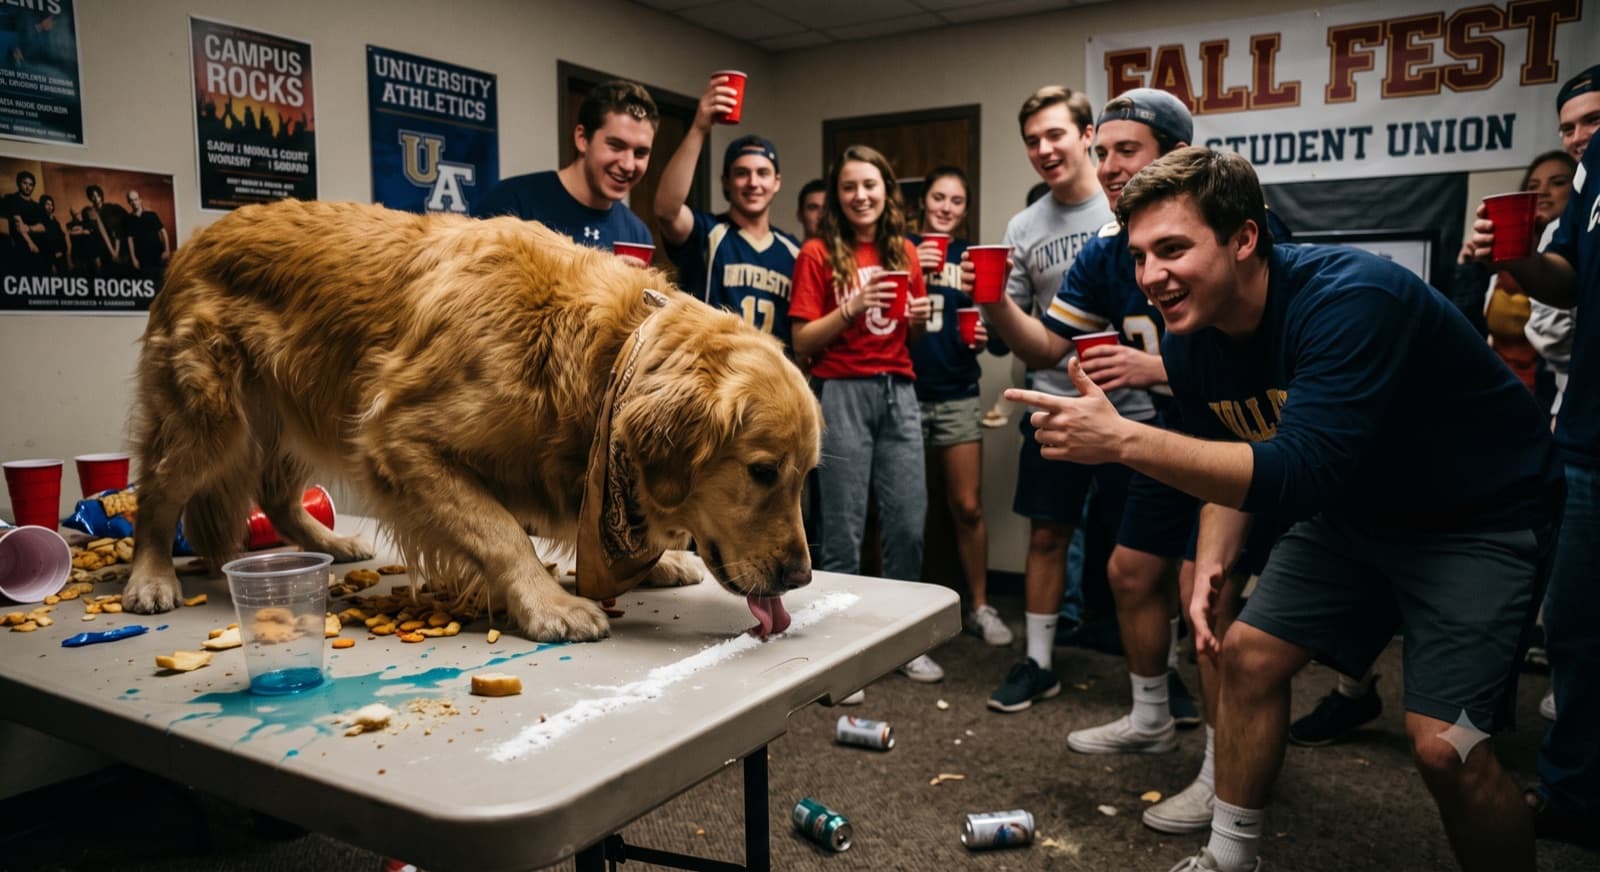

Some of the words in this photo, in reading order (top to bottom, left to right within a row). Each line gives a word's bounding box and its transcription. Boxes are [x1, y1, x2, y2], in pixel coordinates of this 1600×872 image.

[204, 34, 303, 77] CAMPUS
[374, 54, 493, 99] UNIVERSITY
[1103, 32, 1302, 117] FALL
[1324, 0, 1583, 105] FEST
[206, 61, 305, 108] ROCKS
[382, 82, 486, 121] ATHLETICS
[1386, 112, 1517, 157] UNION
[3, 275, 88, 296] CAMPUS
[94, 278, 156, 298] ROCKS
[740, 295, 775, 335] 17
